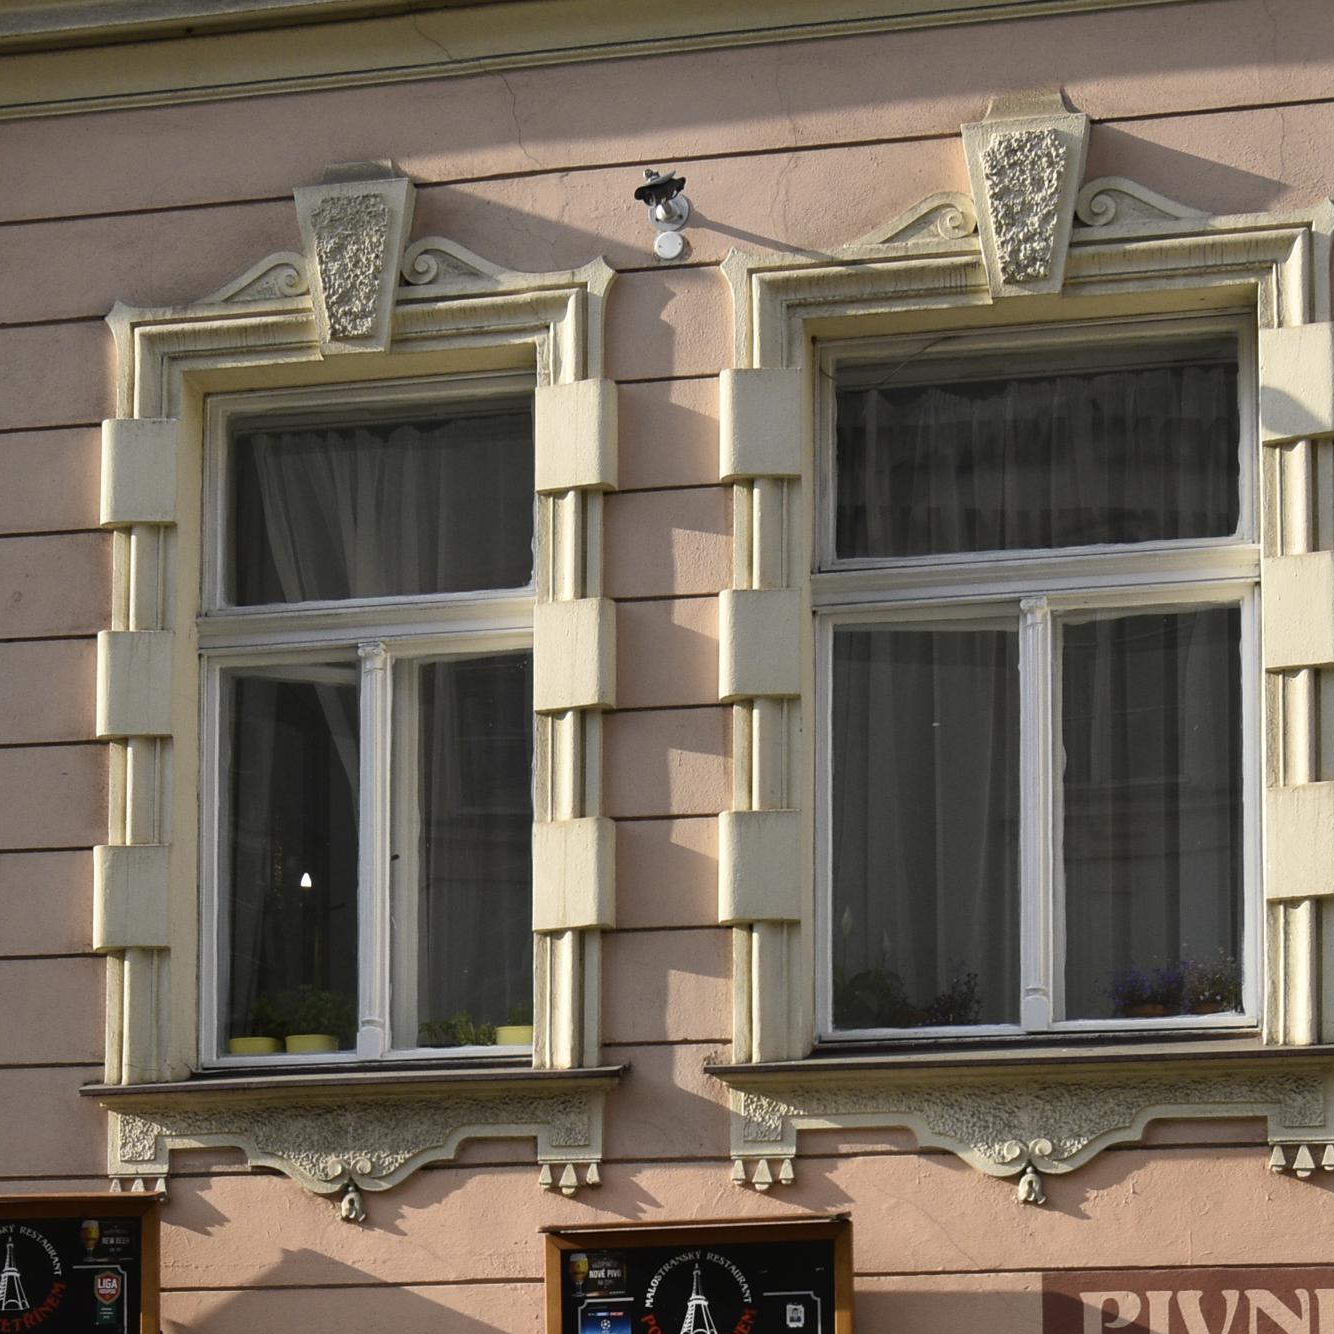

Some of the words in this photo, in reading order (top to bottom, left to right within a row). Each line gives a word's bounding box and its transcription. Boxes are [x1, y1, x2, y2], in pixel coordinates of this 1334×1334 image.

[19, 1225, 62, 1276] RESTAURANT
[97, 1278, 118, 1289] LIGA
[706, 1251, 752, 1304] RESTAURANT
